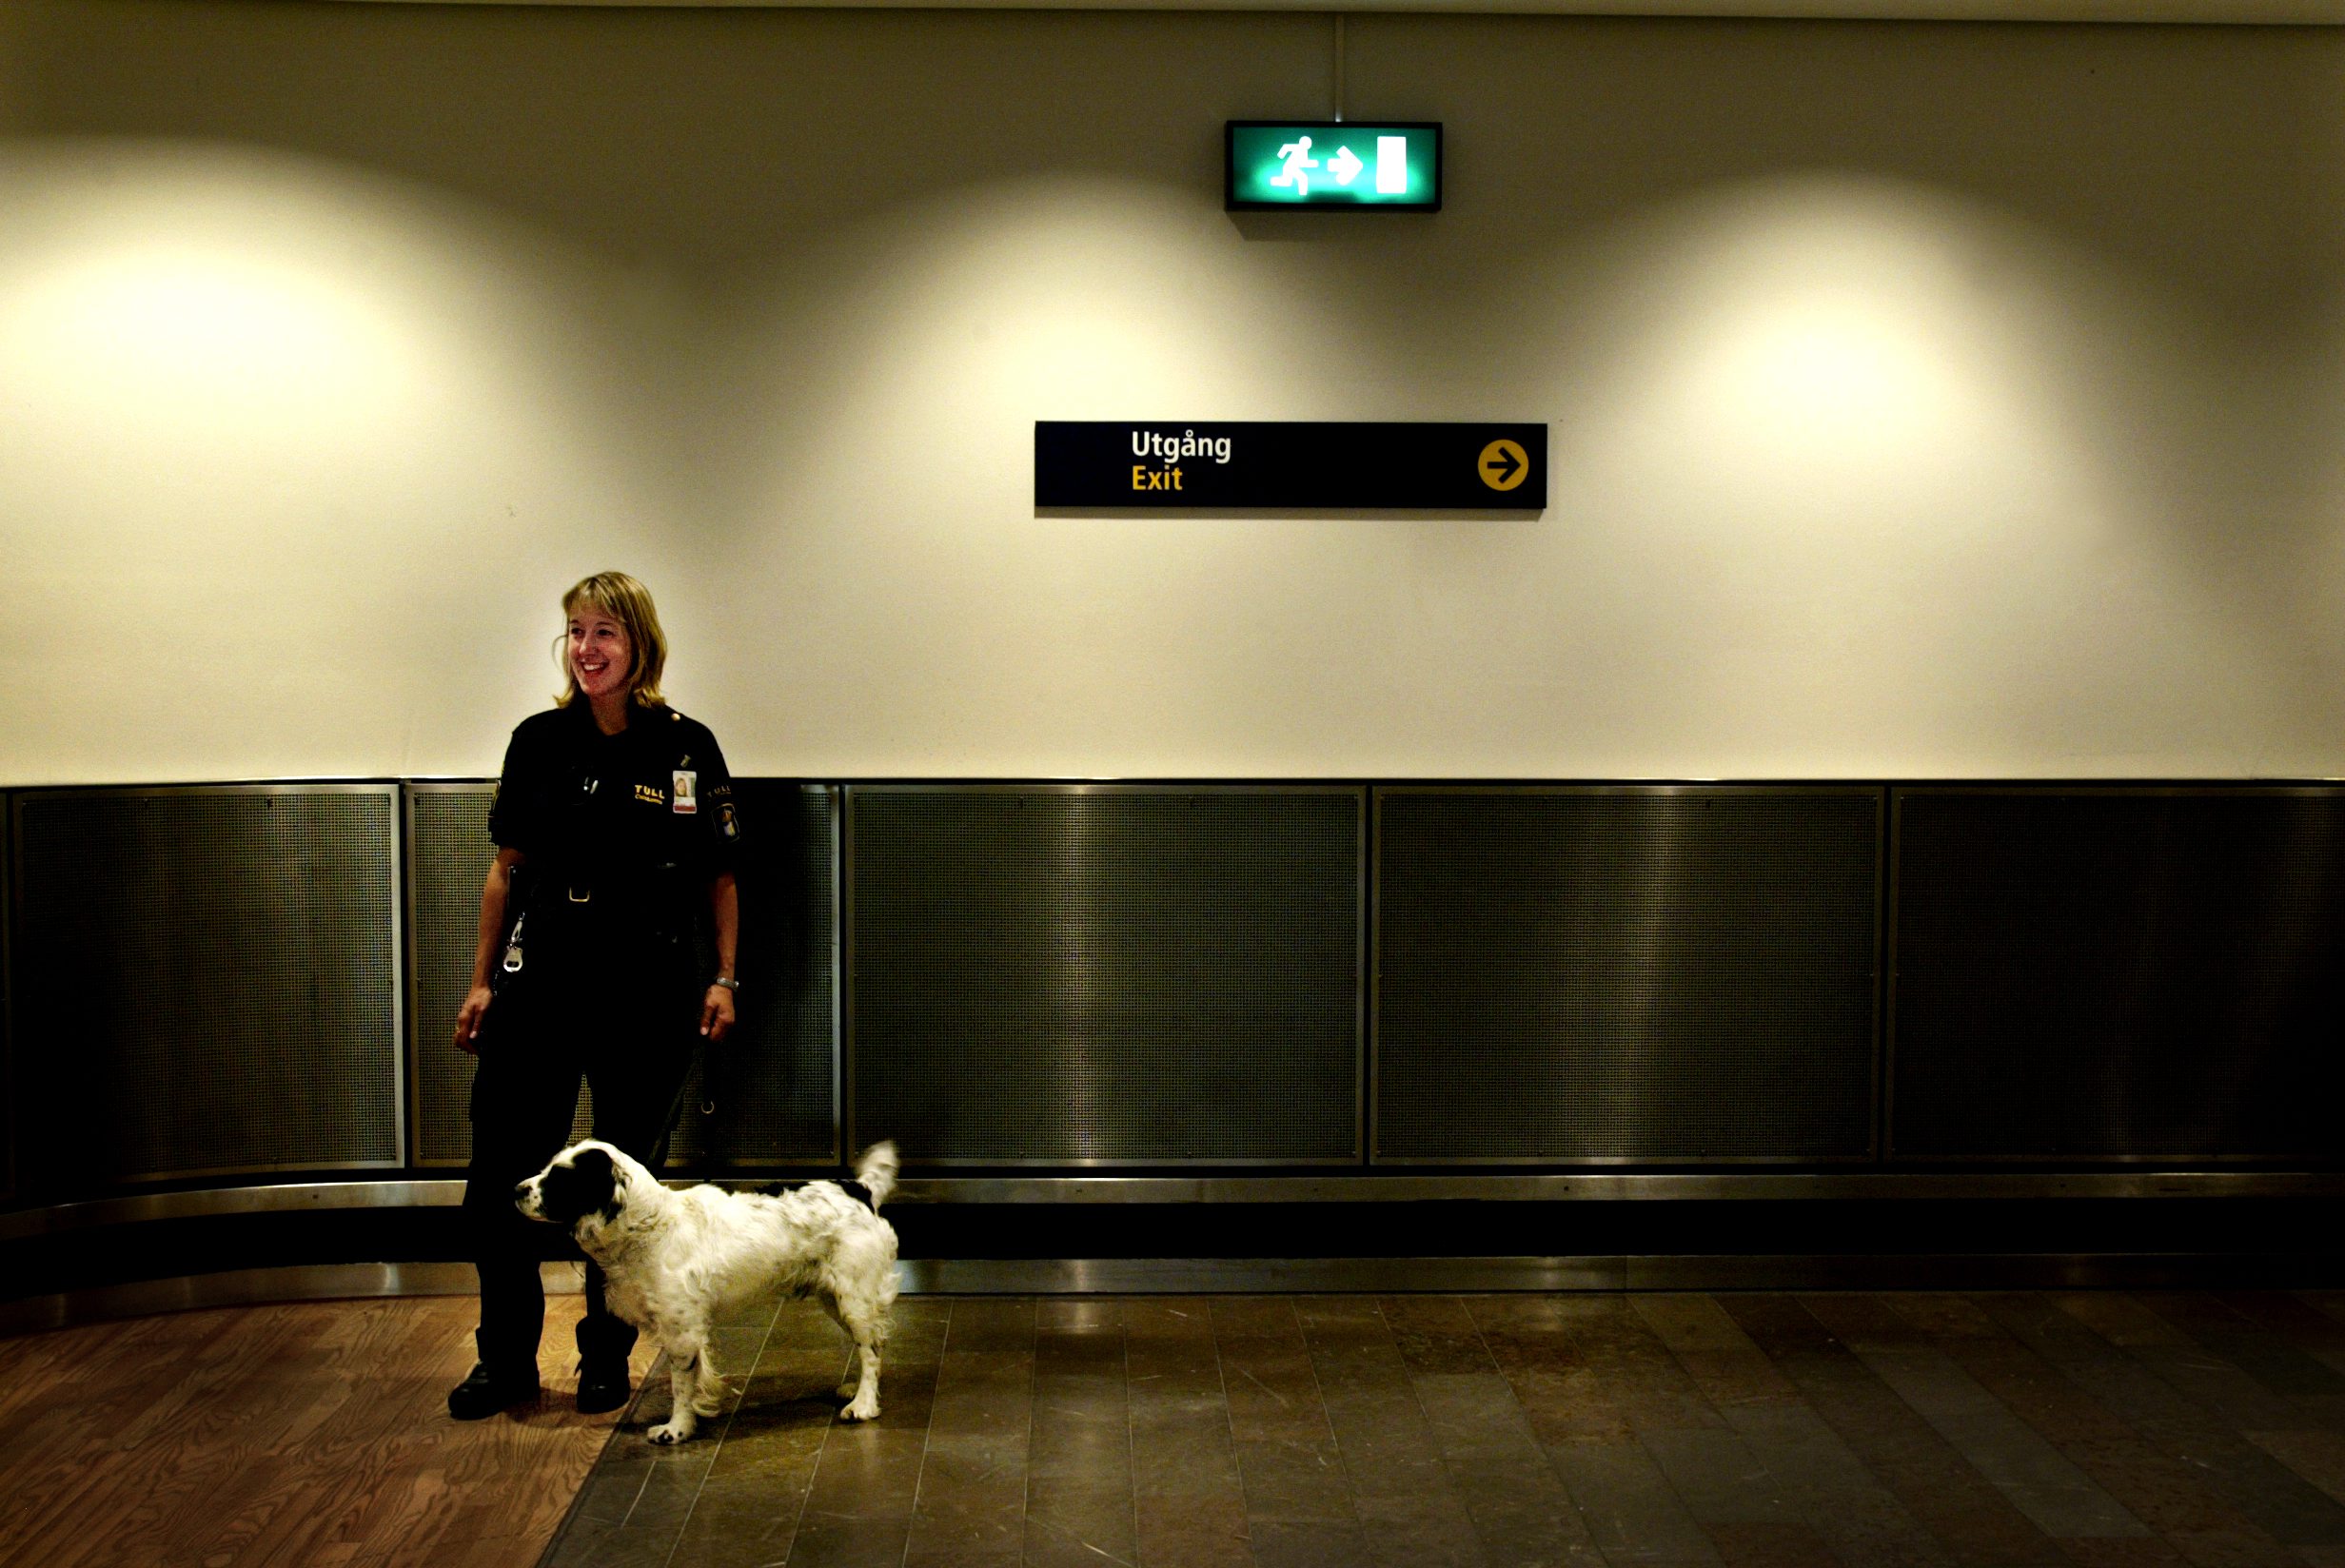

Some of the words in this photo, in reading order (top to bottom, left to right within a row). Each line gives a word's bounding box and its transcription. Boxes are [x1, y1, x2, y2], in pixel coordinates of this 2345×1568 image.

[1132, 429, 1232, 464] Utgång
[1132, 465, 1183, 491] Exit
[634, 784, 665, 799] TULL
